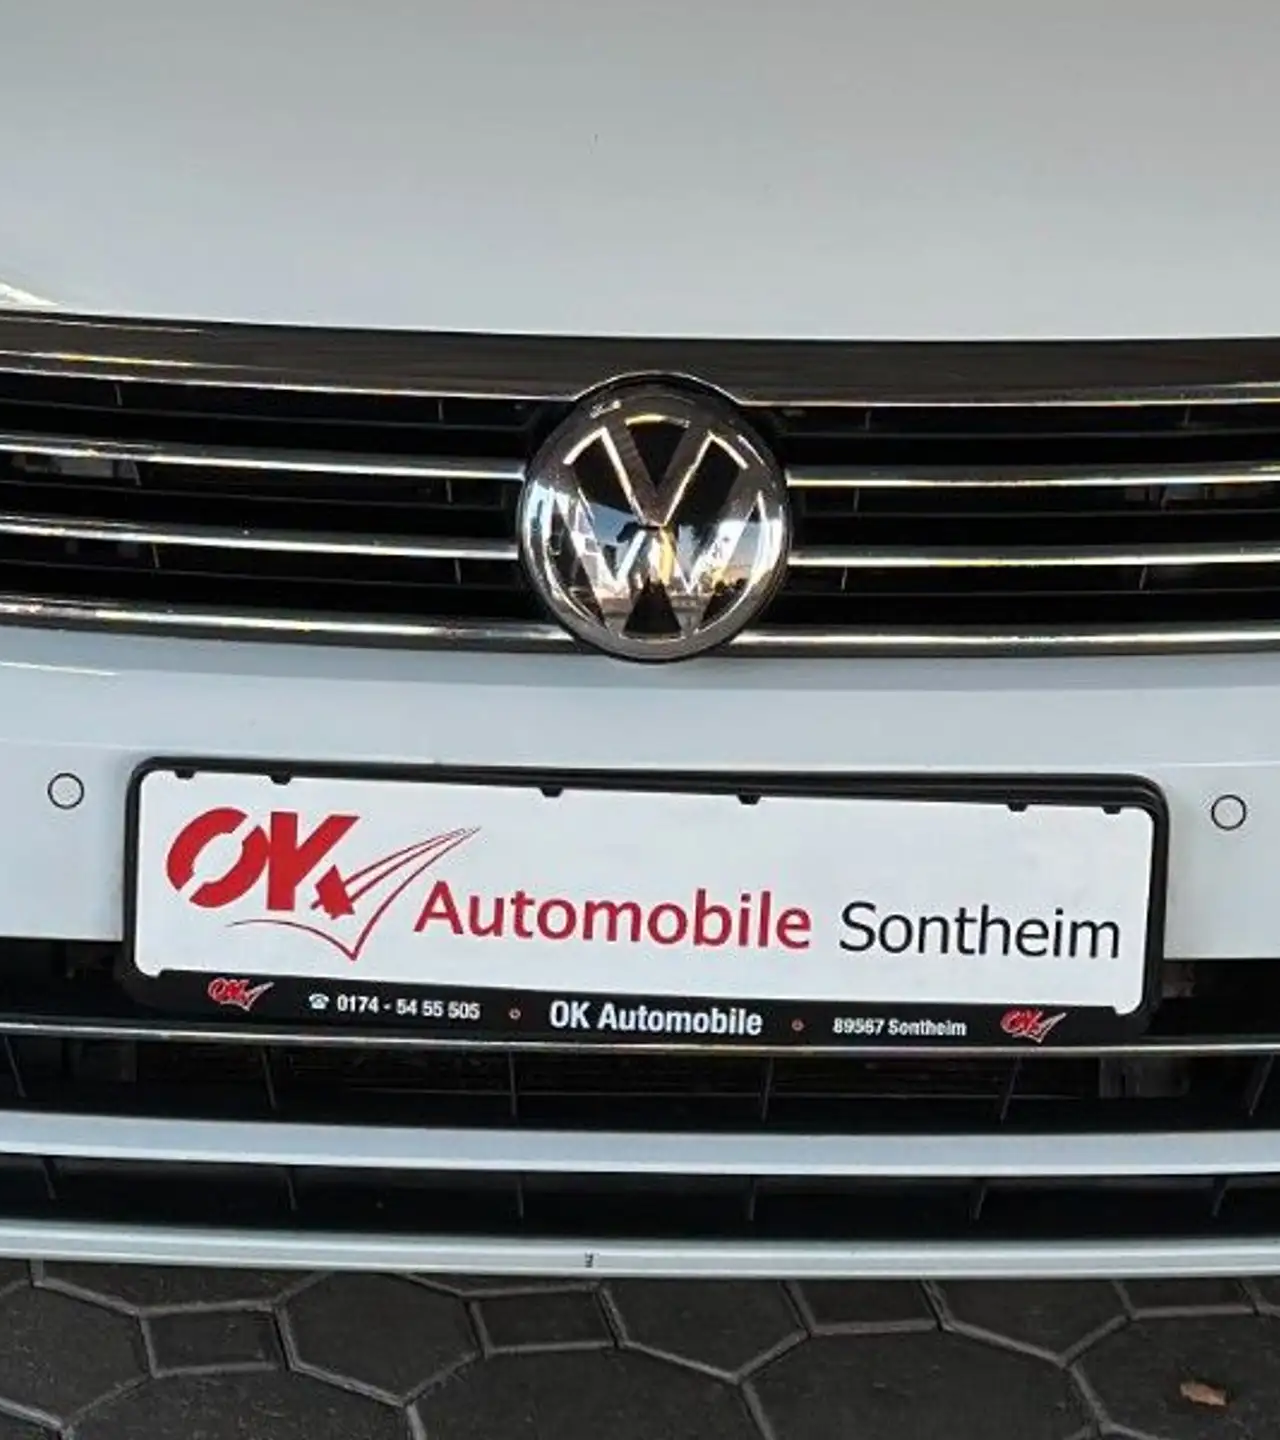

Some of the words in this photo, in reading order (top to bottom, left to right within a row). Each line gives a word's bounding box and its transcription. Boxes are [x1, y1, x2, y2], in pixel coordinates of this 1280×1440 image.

[166, 806, 361, 921] OK
[413, 880, 812, 949] Automobile
[838, 901, 1120, 960] Sontheim
[337, 994, 379, 1013] 0174
[396, 998, 418, 1015] 54
[422, 1000, 444, 1017] 55
[447, 1002, 481, 1019] 505
[549, 999, 590, 1030] OK
[595, 1002, 764, 1036] Automobile
[887, 1018, 967, 1037] Sontheim
